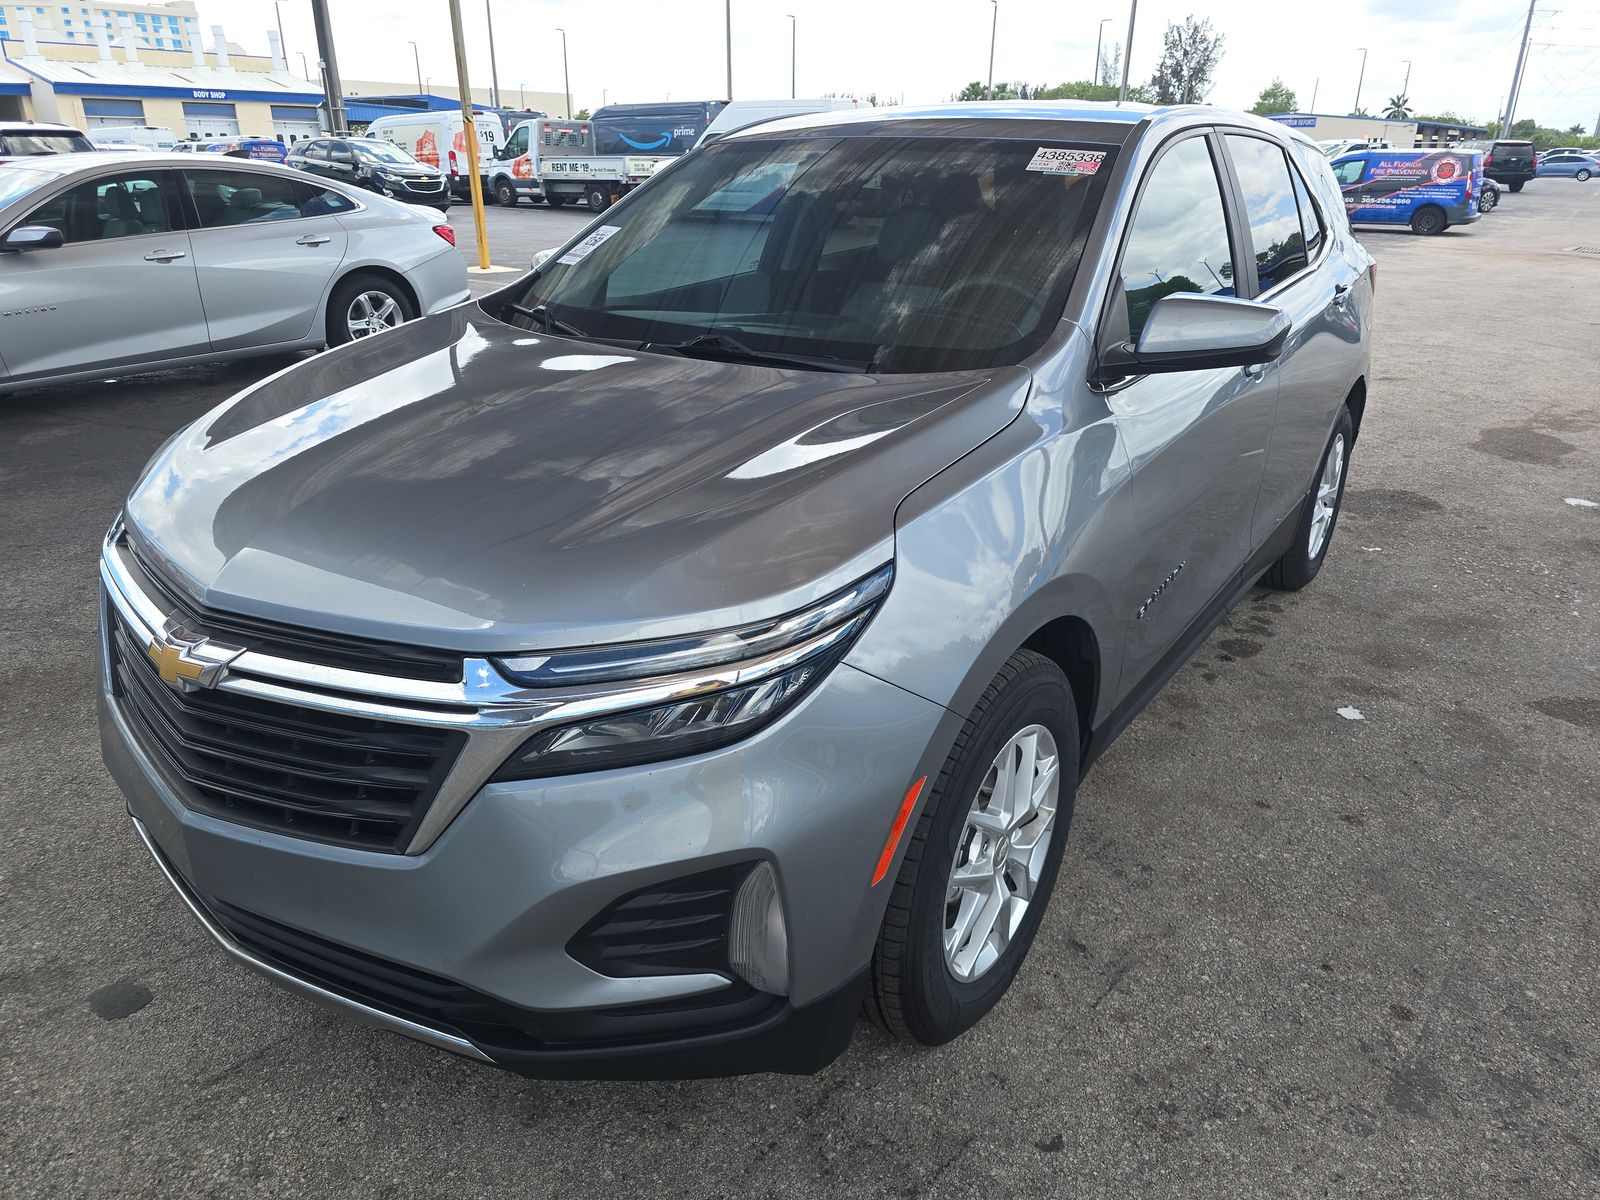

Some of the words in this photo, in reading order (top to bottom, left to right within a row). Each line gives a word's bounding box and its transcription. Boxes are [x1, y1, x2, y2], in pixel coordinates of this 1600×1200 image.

[210, 91, 226, 99] SHOP
[480, 130, 494, 142] $19
[674, 126, 694, 140] prime
[1038, 151, 1104, 163] 4385338
[552, 163, 567, 172] RENT
[569, 163, 578, 172] ME
